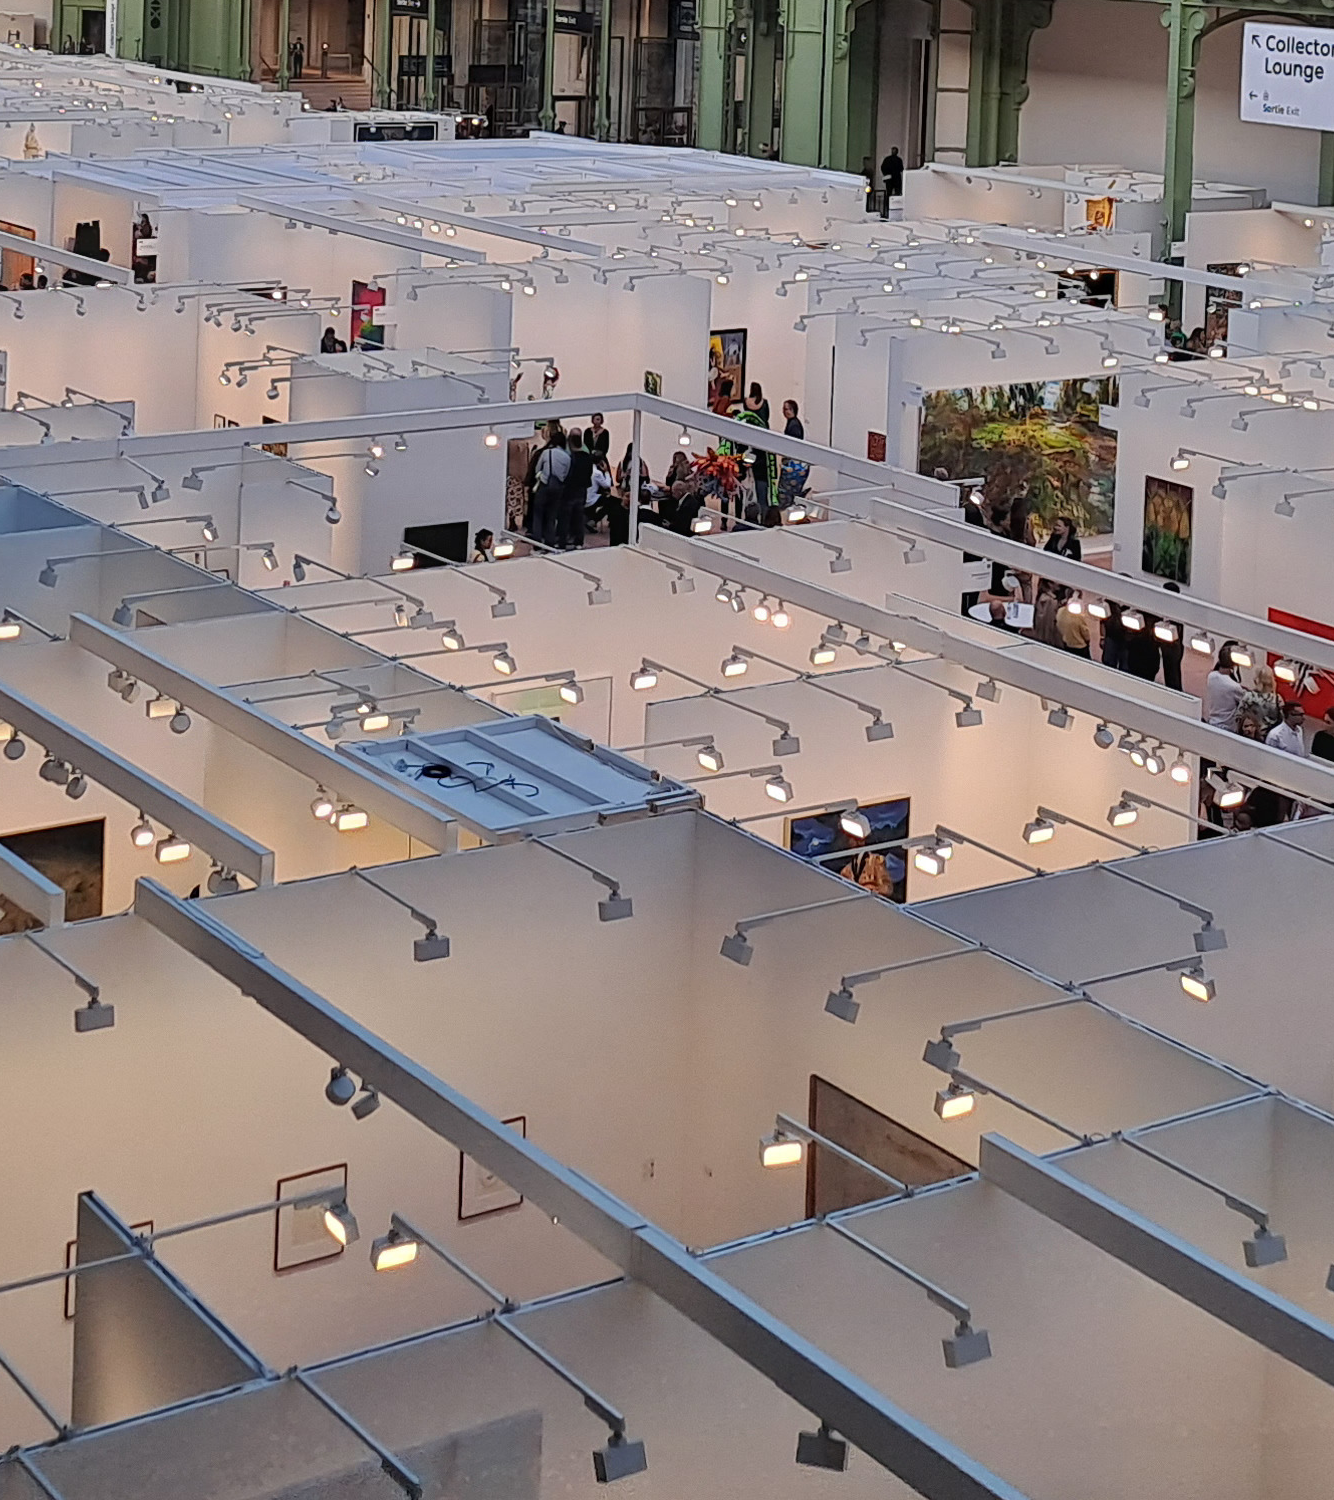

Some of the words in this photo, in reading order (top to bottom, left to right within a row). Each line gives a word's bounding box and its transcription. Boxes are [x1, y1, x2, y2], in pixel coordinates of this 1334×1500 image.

[1264, 57, 1324, 83] Lounge
[1262, 103, 1285, 115] Sortie
[1286, 106, 1300, 117] Exit
